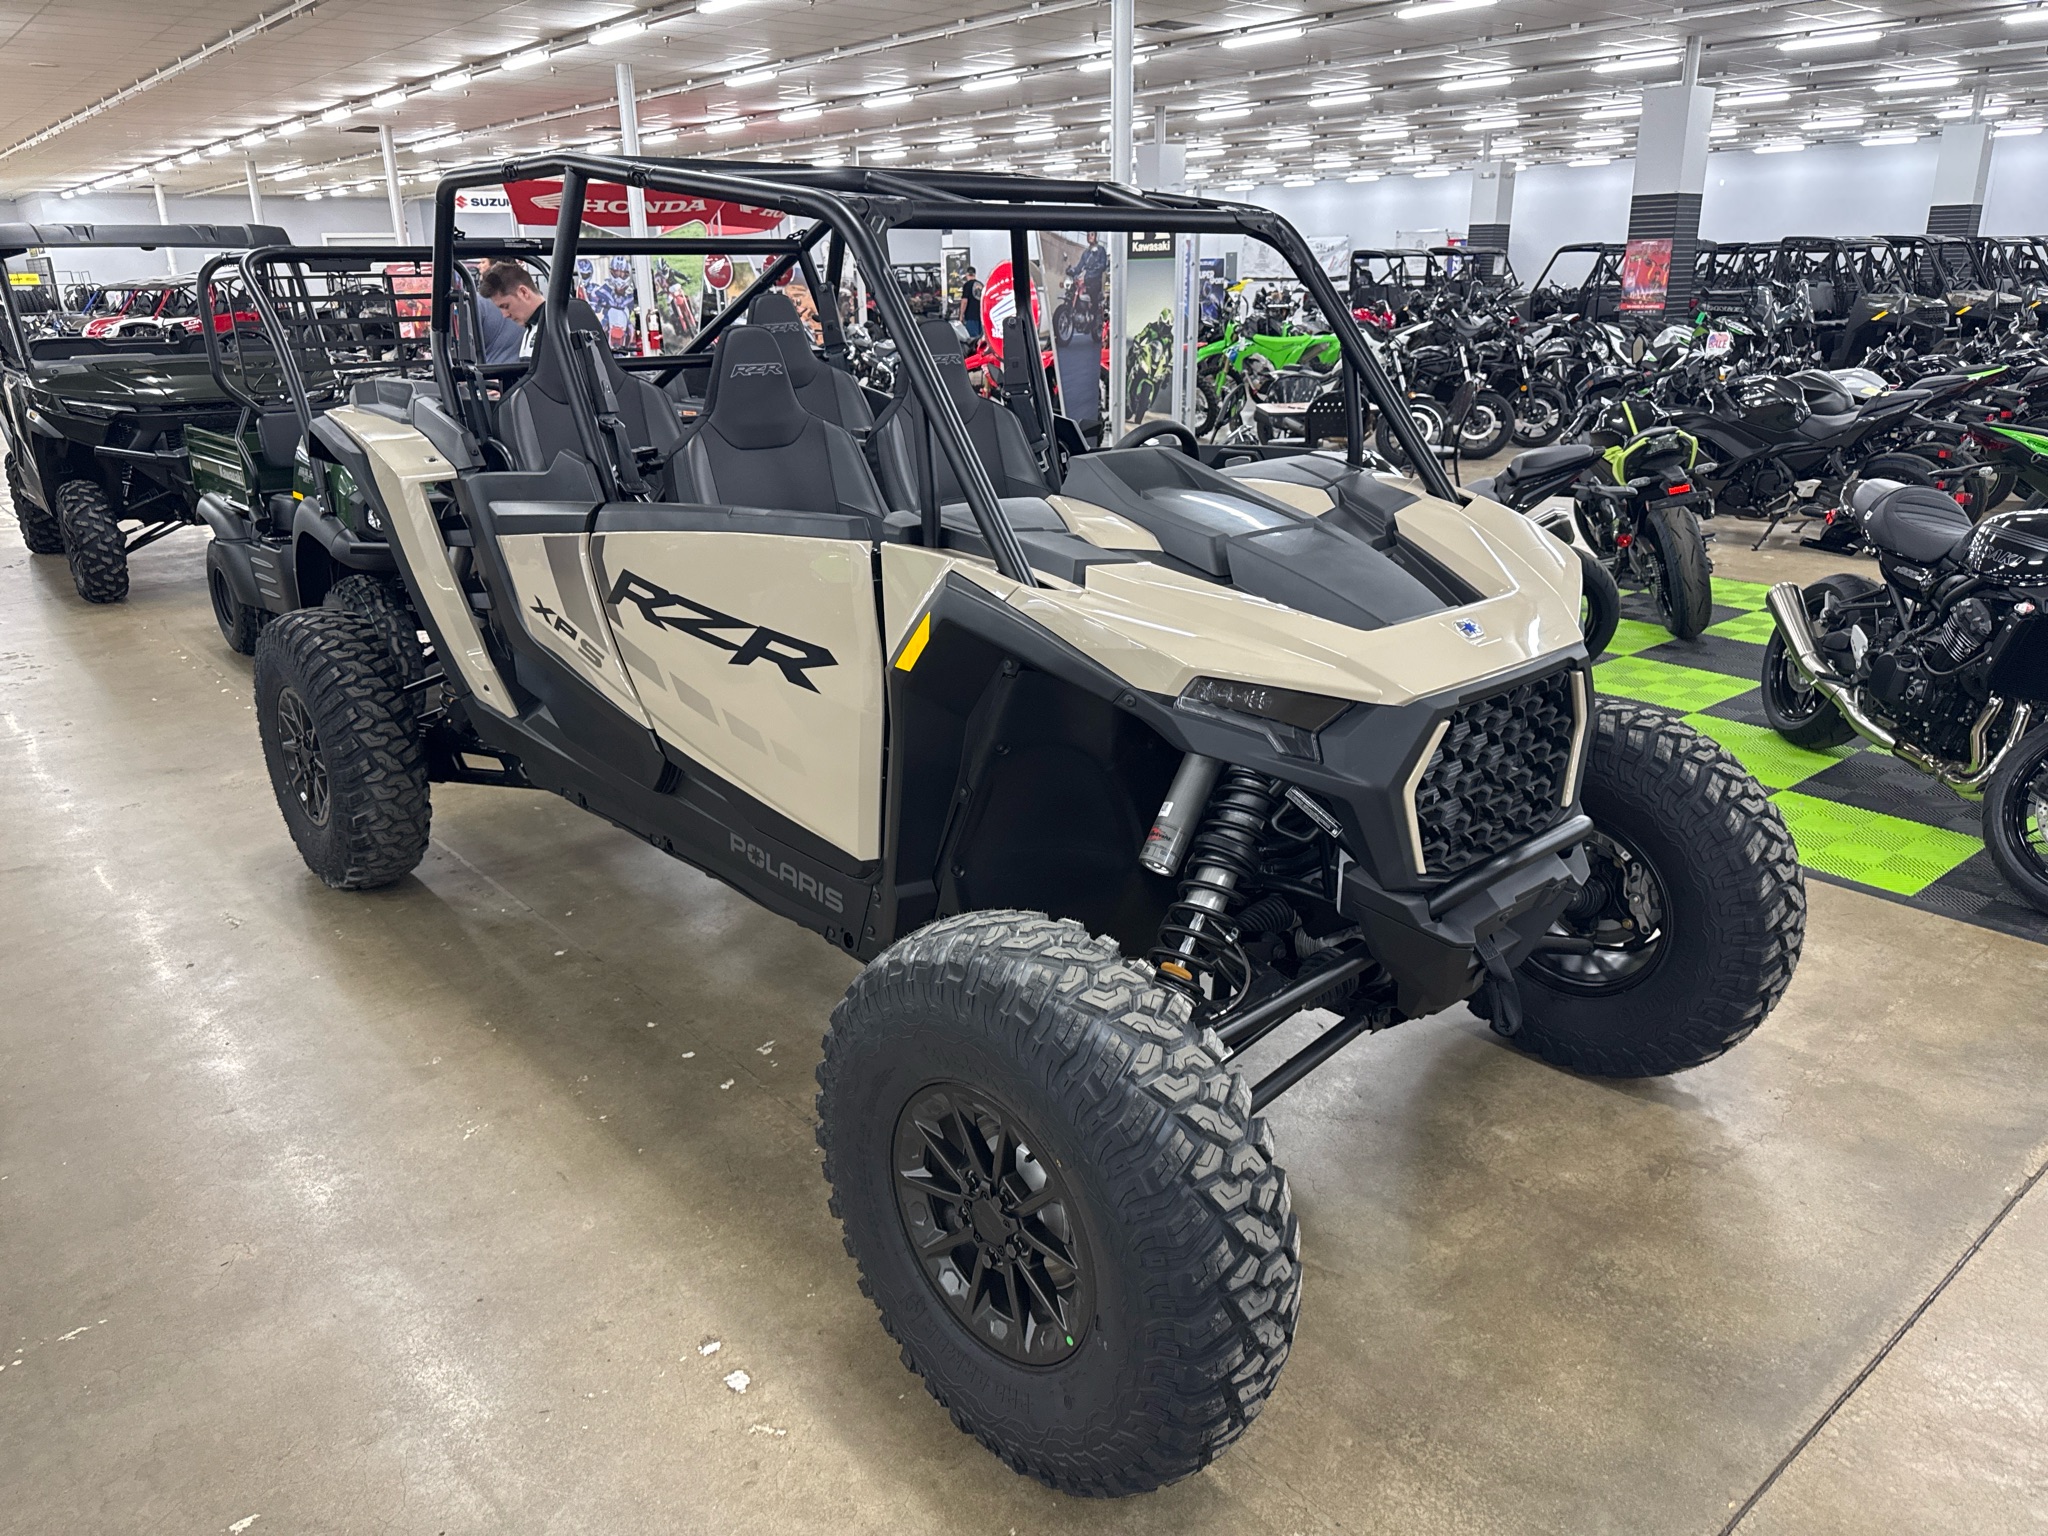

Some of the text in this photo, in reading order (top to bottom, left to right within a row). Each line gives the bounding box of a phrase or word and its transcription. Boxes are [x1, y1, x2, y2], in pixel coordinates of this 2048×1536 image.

[470, 197, 511, 207] SUZU
[582, 198, 708, 215] HONDA
[1132, 240, 1171, 252] Kawasaki
[1199, 270, 1215, 279] UPER
[931, 353, 962, 365] ZR
[730, 362, 784, 379] RZR
[606, 568, 840, 695] RZR
[729, 832, 844, 913] POLARIS
